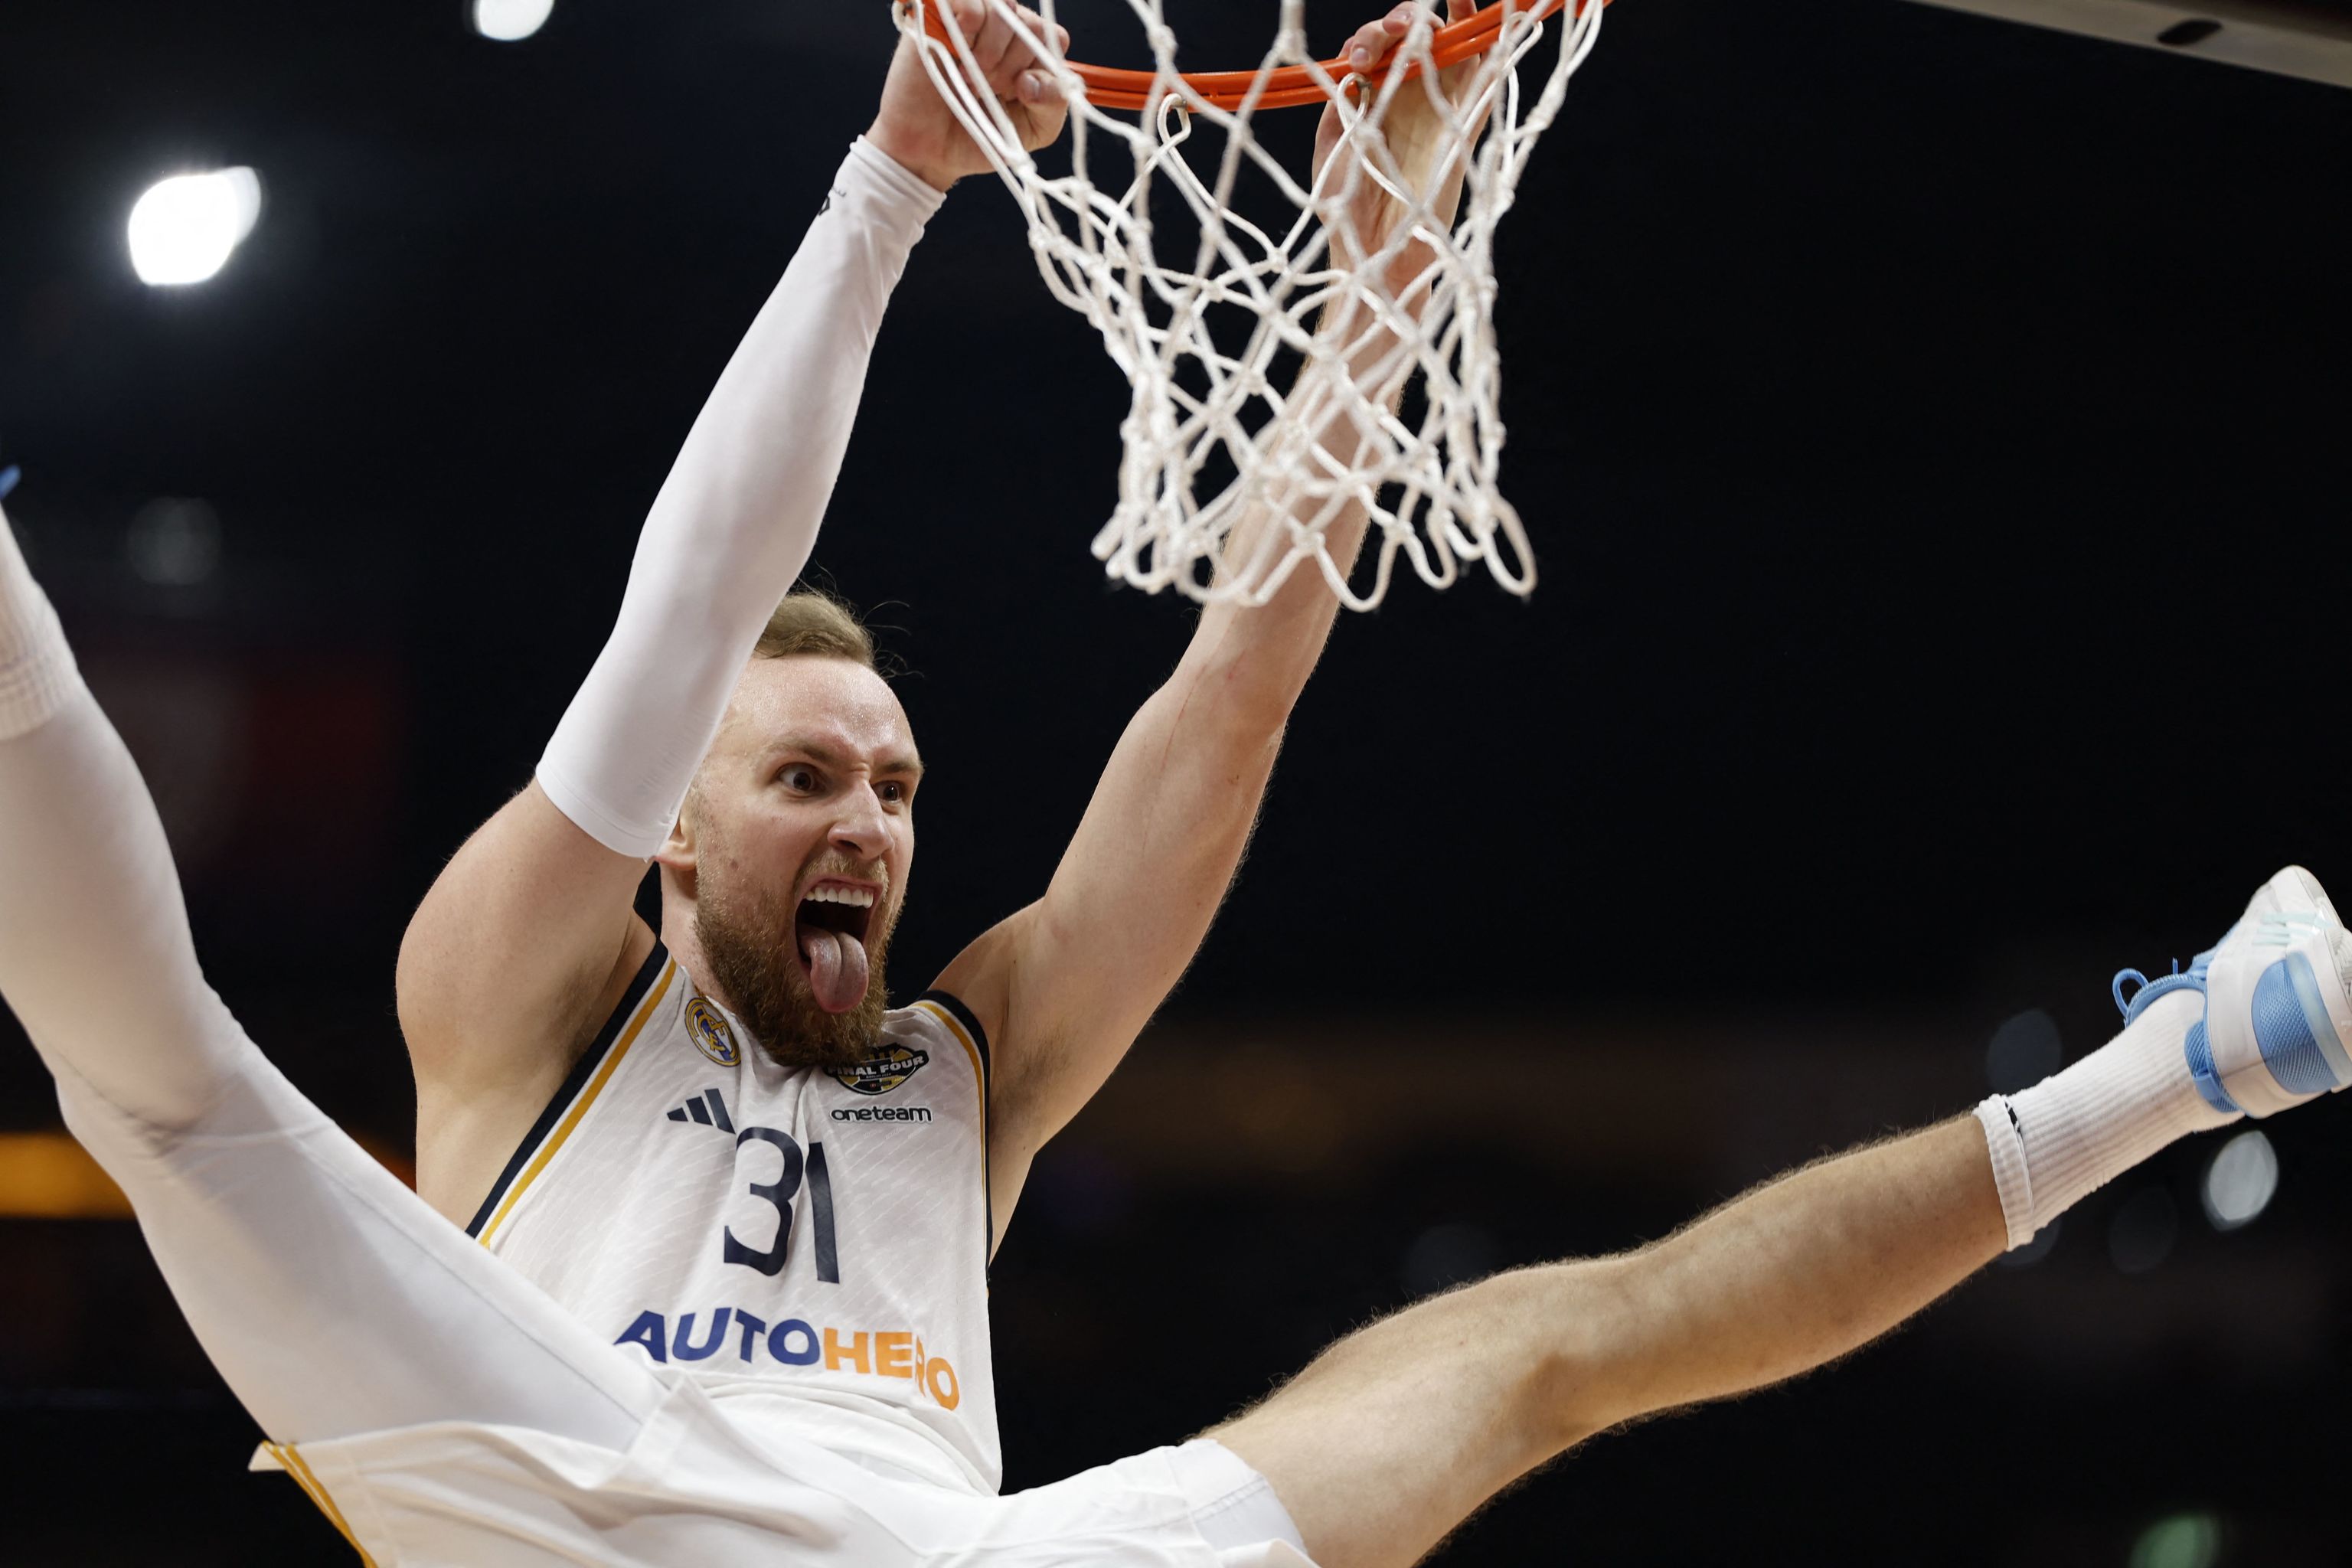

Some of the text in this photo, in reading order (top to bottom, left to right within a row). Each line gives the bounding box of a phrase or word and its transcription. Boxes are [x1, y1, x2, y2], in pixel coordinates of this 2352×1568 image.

[879, 1057, 924, 1074] FOUR
[831, 1106, 932, 1122] oneteam
[724, 1127, 840, 1284] 31
